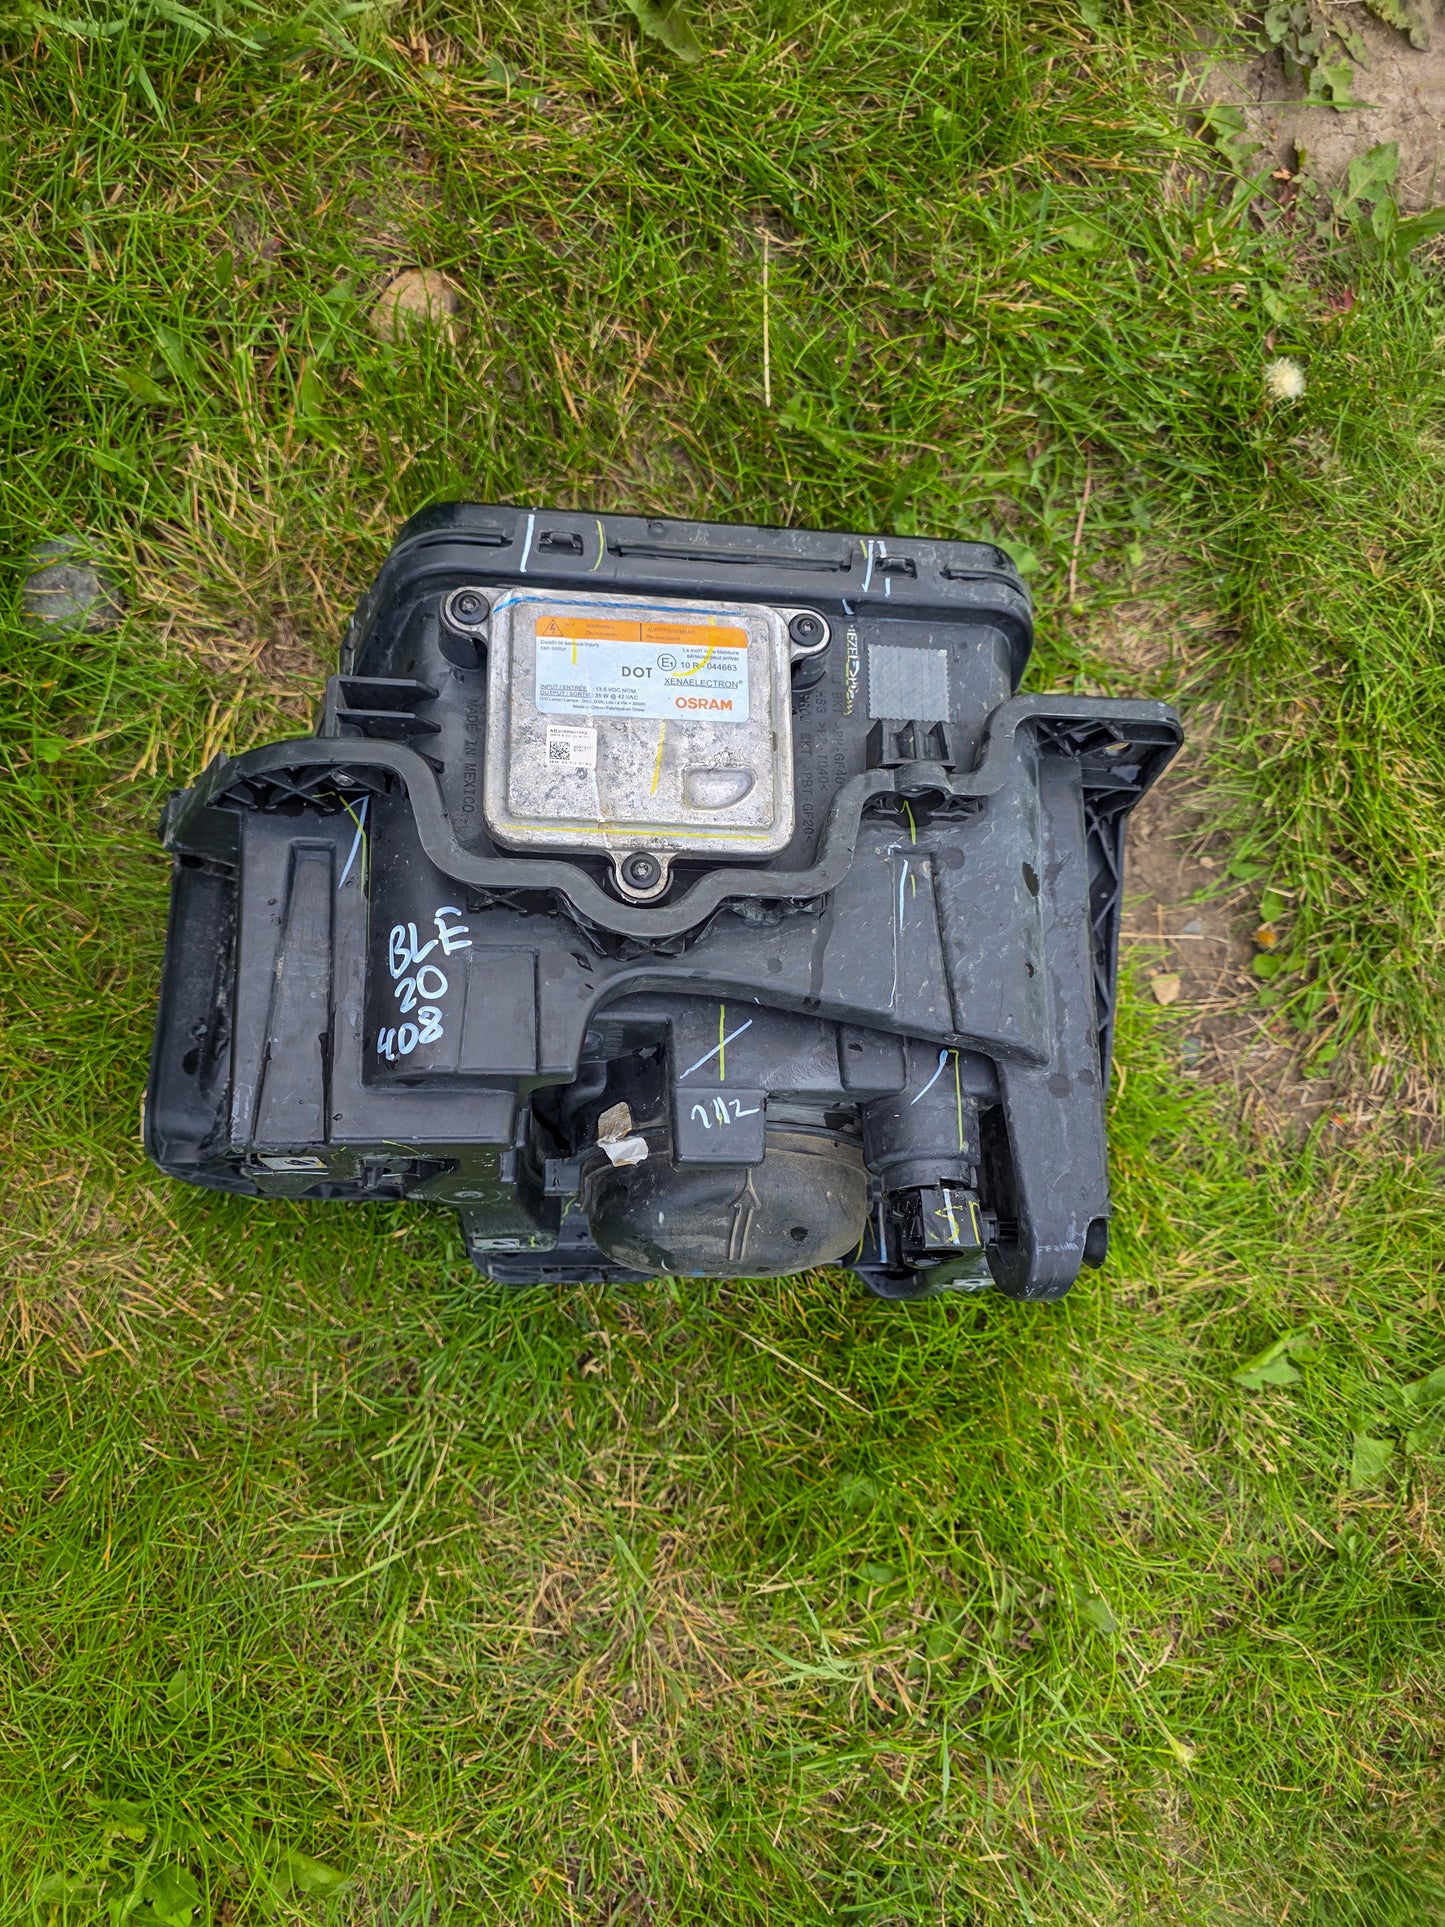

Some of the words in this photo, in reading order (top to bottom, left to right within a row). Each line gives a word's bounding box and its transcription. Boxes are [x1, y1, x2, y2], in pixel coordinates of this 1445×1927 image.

[621, 665, 653, 679] DOT
[680, 661, 691, 669] 10
[706, 662, 738, 672] 044663
[464, 697, 478, 732] MADE
[832, 691, 843, 713] BKT
[464, 739, 478, 756] IN
[801, 732, 812, 757] BKT
[462, 763, 477, 813] MEXICO
[394, 964, 449, 1014] 20
[376, 1005, 445, 1061] 408
